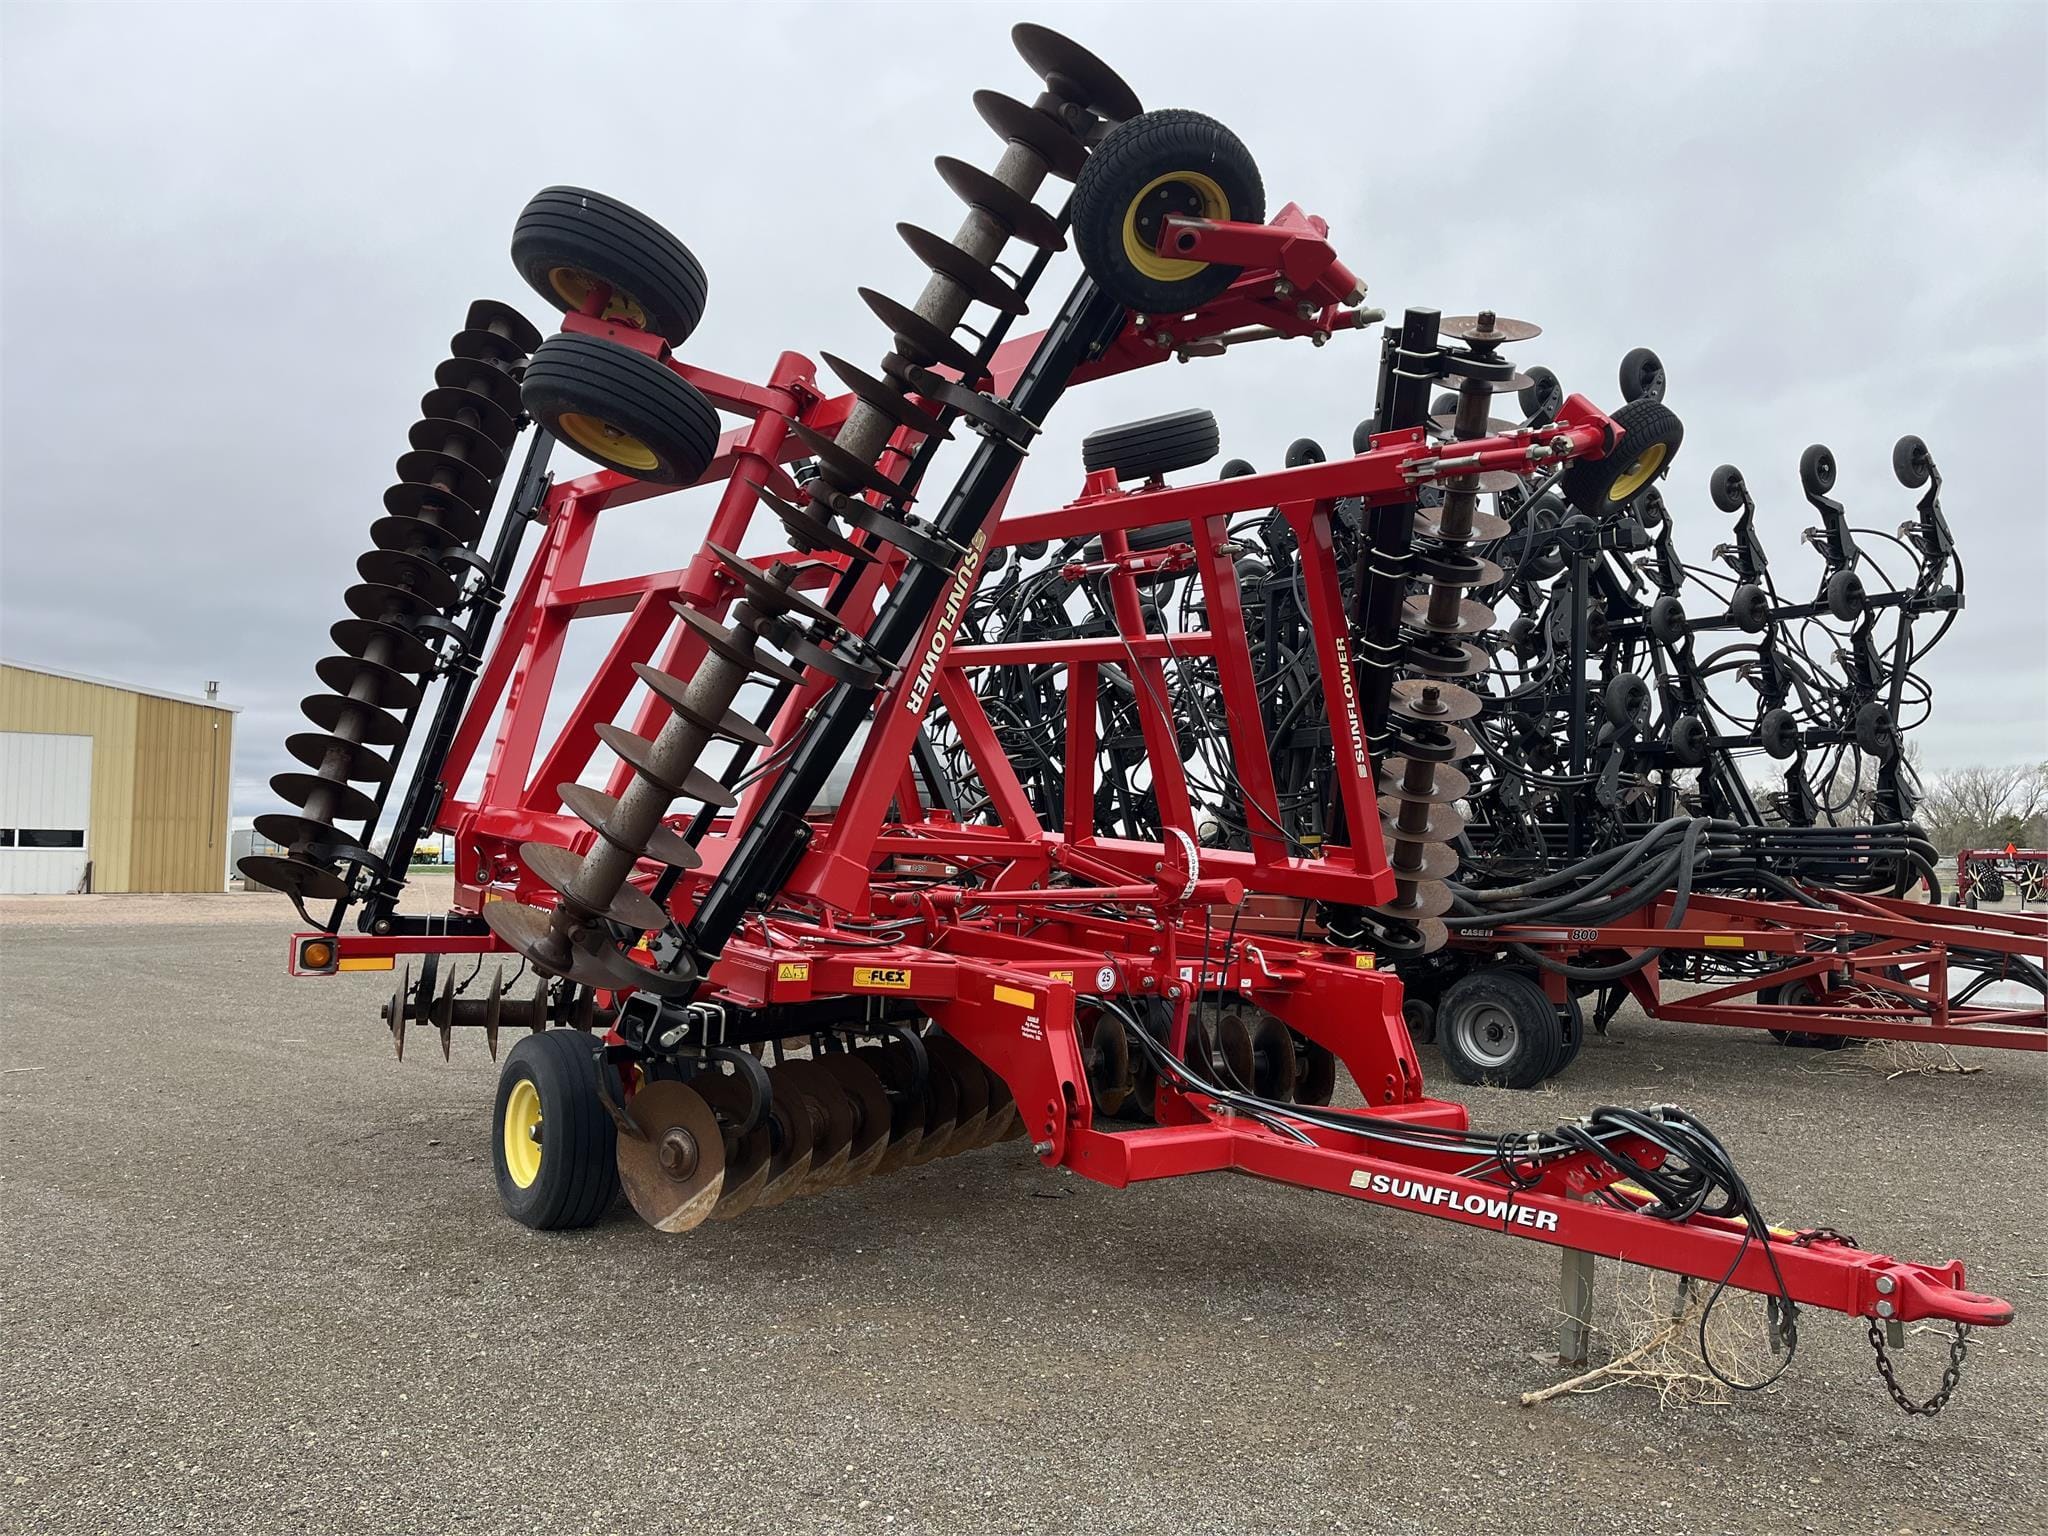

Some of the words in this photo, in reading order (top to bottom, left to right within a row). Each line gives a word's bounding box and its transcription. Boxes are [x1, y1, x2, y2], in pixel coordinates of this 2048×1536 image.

[905, 549, 980, 715] SUNFLOWER
[1335, 636, 1365, 763] SUNFLOWER
[1460, 928, 1485, 937] CASE
[1572, 929, 1598, 941] 800
[1101, 971, 1111, 982] 25
[1371, 1173, 1559, 1232] SUNFLOWER
